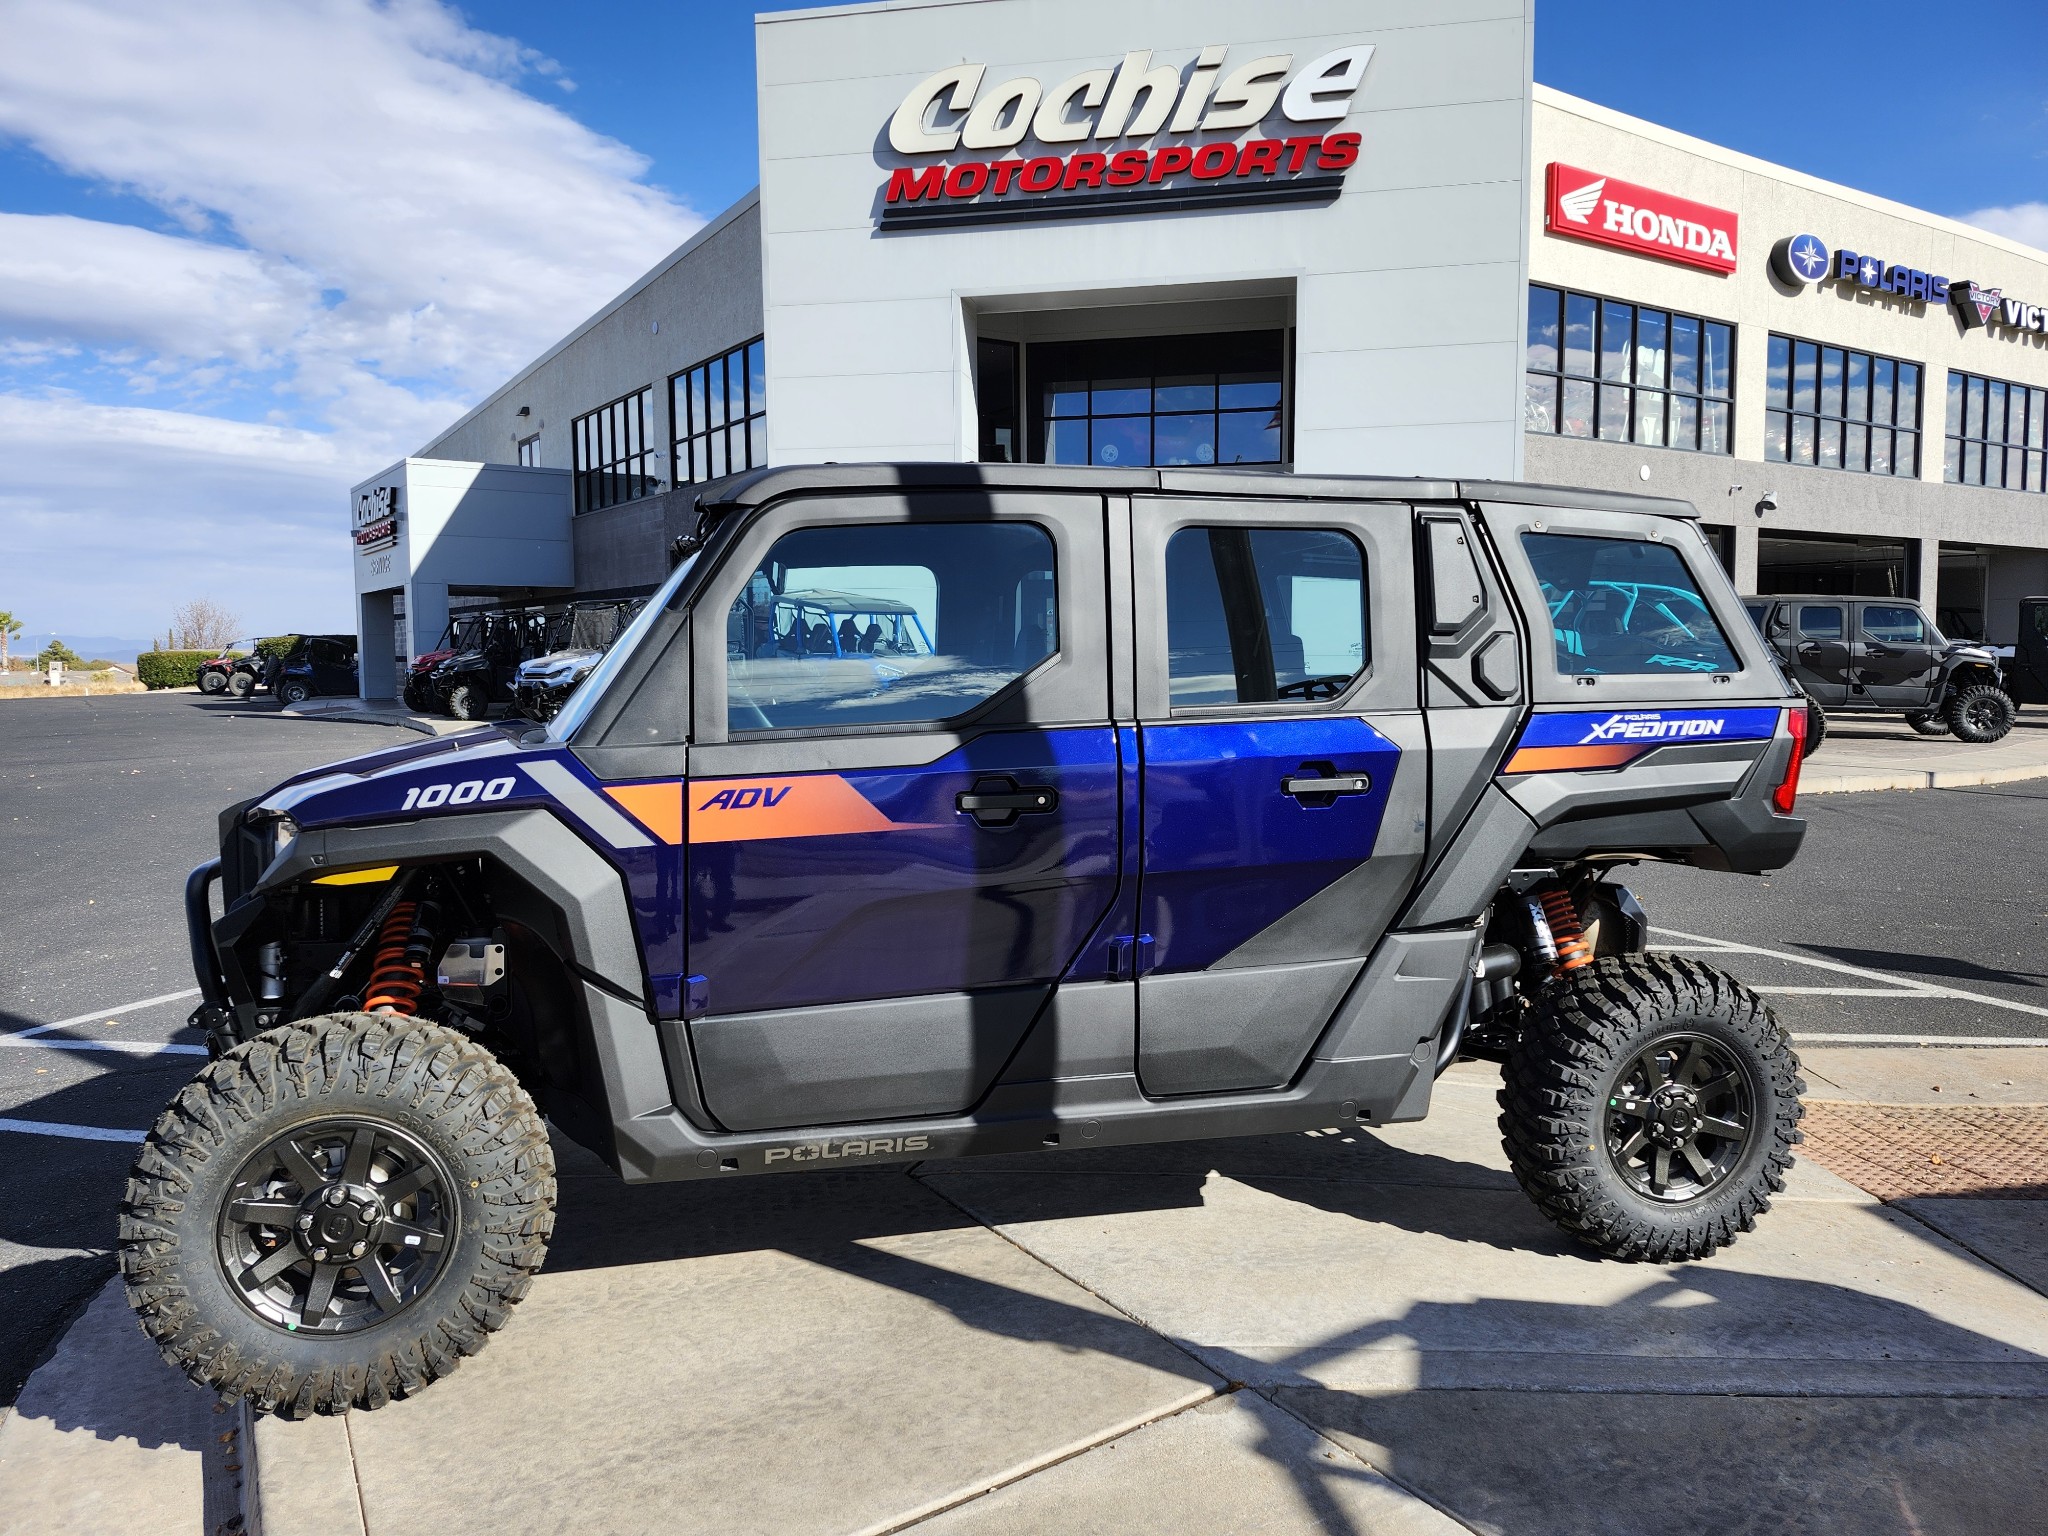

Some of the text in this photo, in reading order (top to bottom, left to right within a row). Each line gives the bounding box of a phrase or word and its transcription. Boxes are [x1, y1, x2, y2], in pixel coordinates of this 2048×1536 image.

[888, 44, 1376, 154] Cochise
[885, 132, 1362, 203] MOTORSPORTS
[1602, 199, 1736, 261] HONDA
[1834, 249, 1949, 305] POLARIS
[1969, 291, 2000, 307] VICTORY
[356, 487, 394, 527] Cochise
[1645, 654, 1719, 672] RZR
[1578, 714, 1724, 744] XPEDITION
[1624, 713, 1661, 721] POLARIS
[401, 777, 516, 811] 1000
[697, 786, 793, 811] ADV
[764, 1135, 929, 1164] POLARIS
